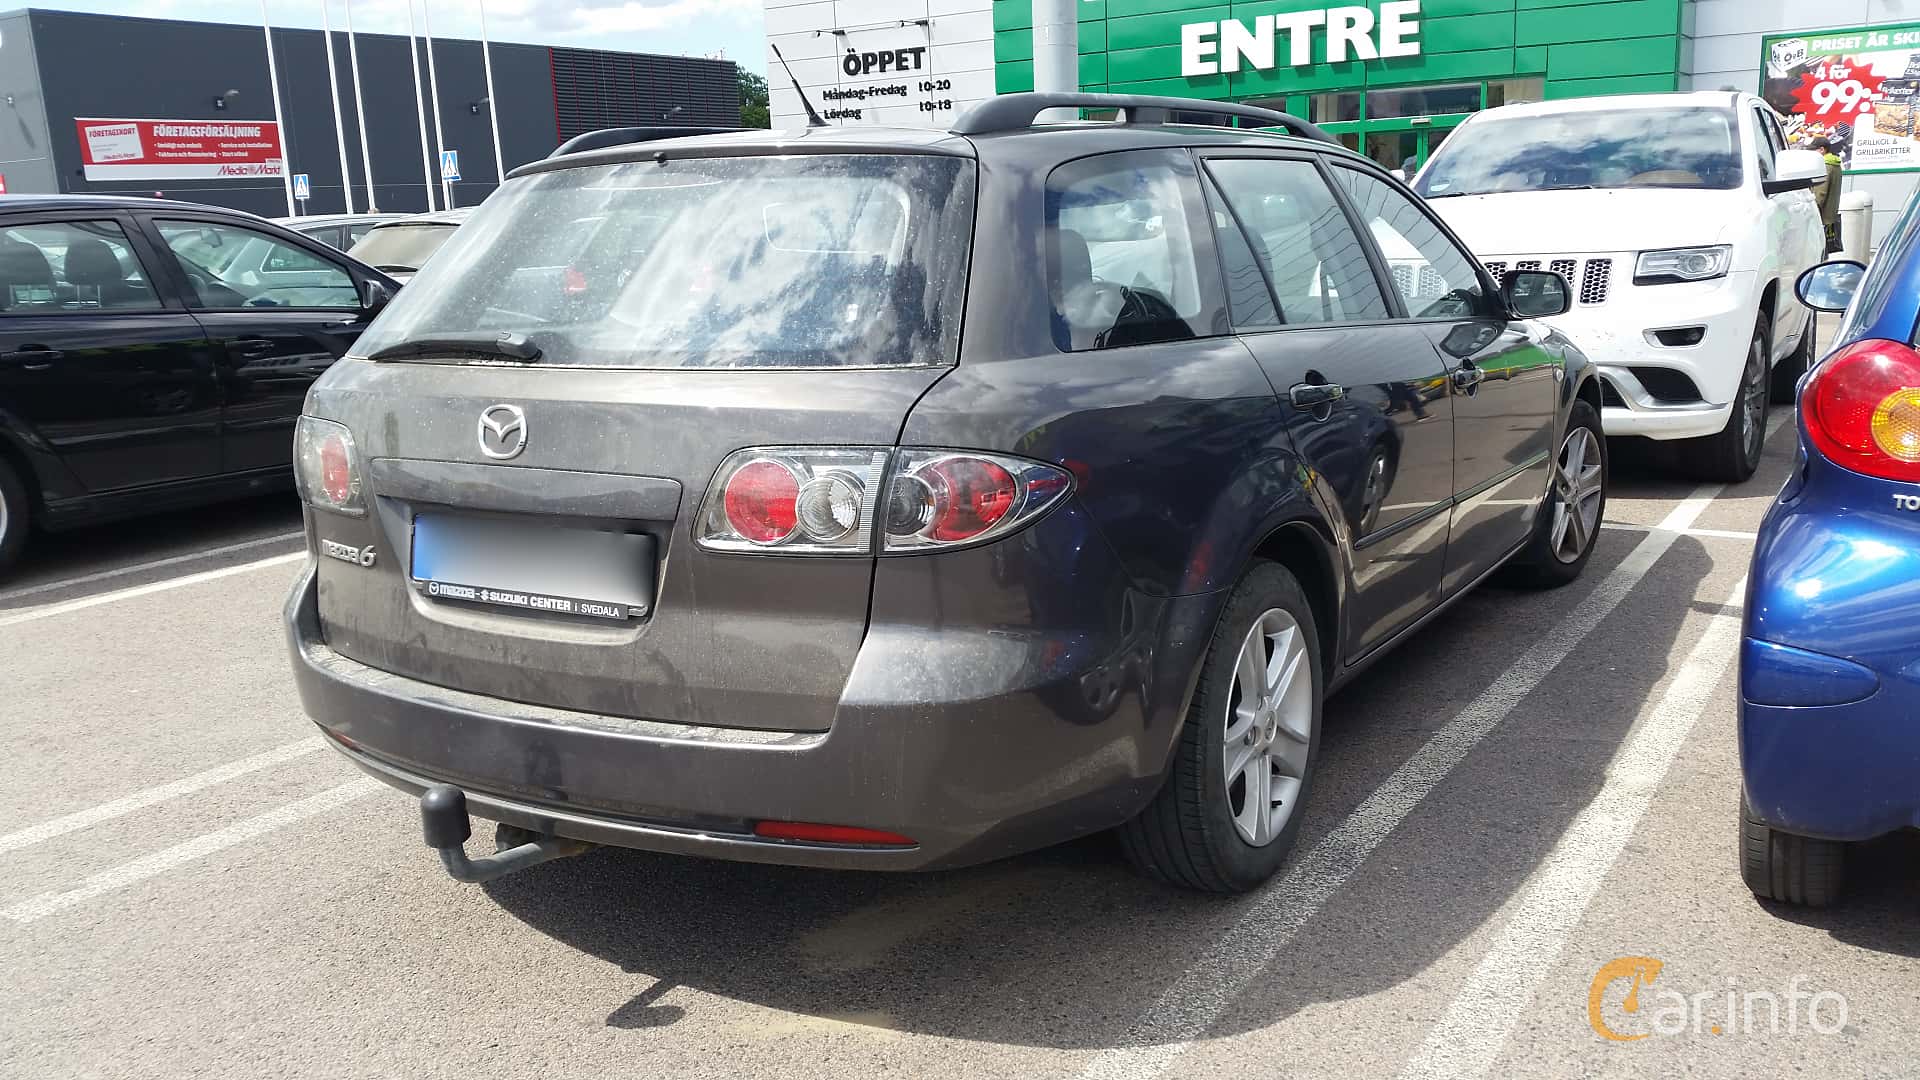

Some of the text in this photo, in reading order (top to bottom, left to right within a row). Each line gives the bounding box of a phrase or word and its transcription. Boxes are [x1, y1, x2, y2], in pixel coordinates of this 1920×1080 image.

[1181, 0, 1421, 76] ENTRE
[1811, 36, 1863, 51] PRISET
[1866, 32, 1888, 47] ÄR
[843, 46, 926, 76] ÖPPET
[1814, 64, 1852, 80] 4 för
[823, 79, 951, 100] Måndag-Fredag 10-20
[824, 99, 951, 120] Lördag 10-18
[153, 123, 261, 139] FÖRETAGSFÖRSÄLJNING
[1855, 146, 1912, 156] GRILLBRIKETTER
[1856, 138, 1890, 147] GRILLKOL
[490, 592, 528, 605] SUZUKI
[530, 596, 571, 611] CENTER
[580, 603, 620, 617] SVEDALA
